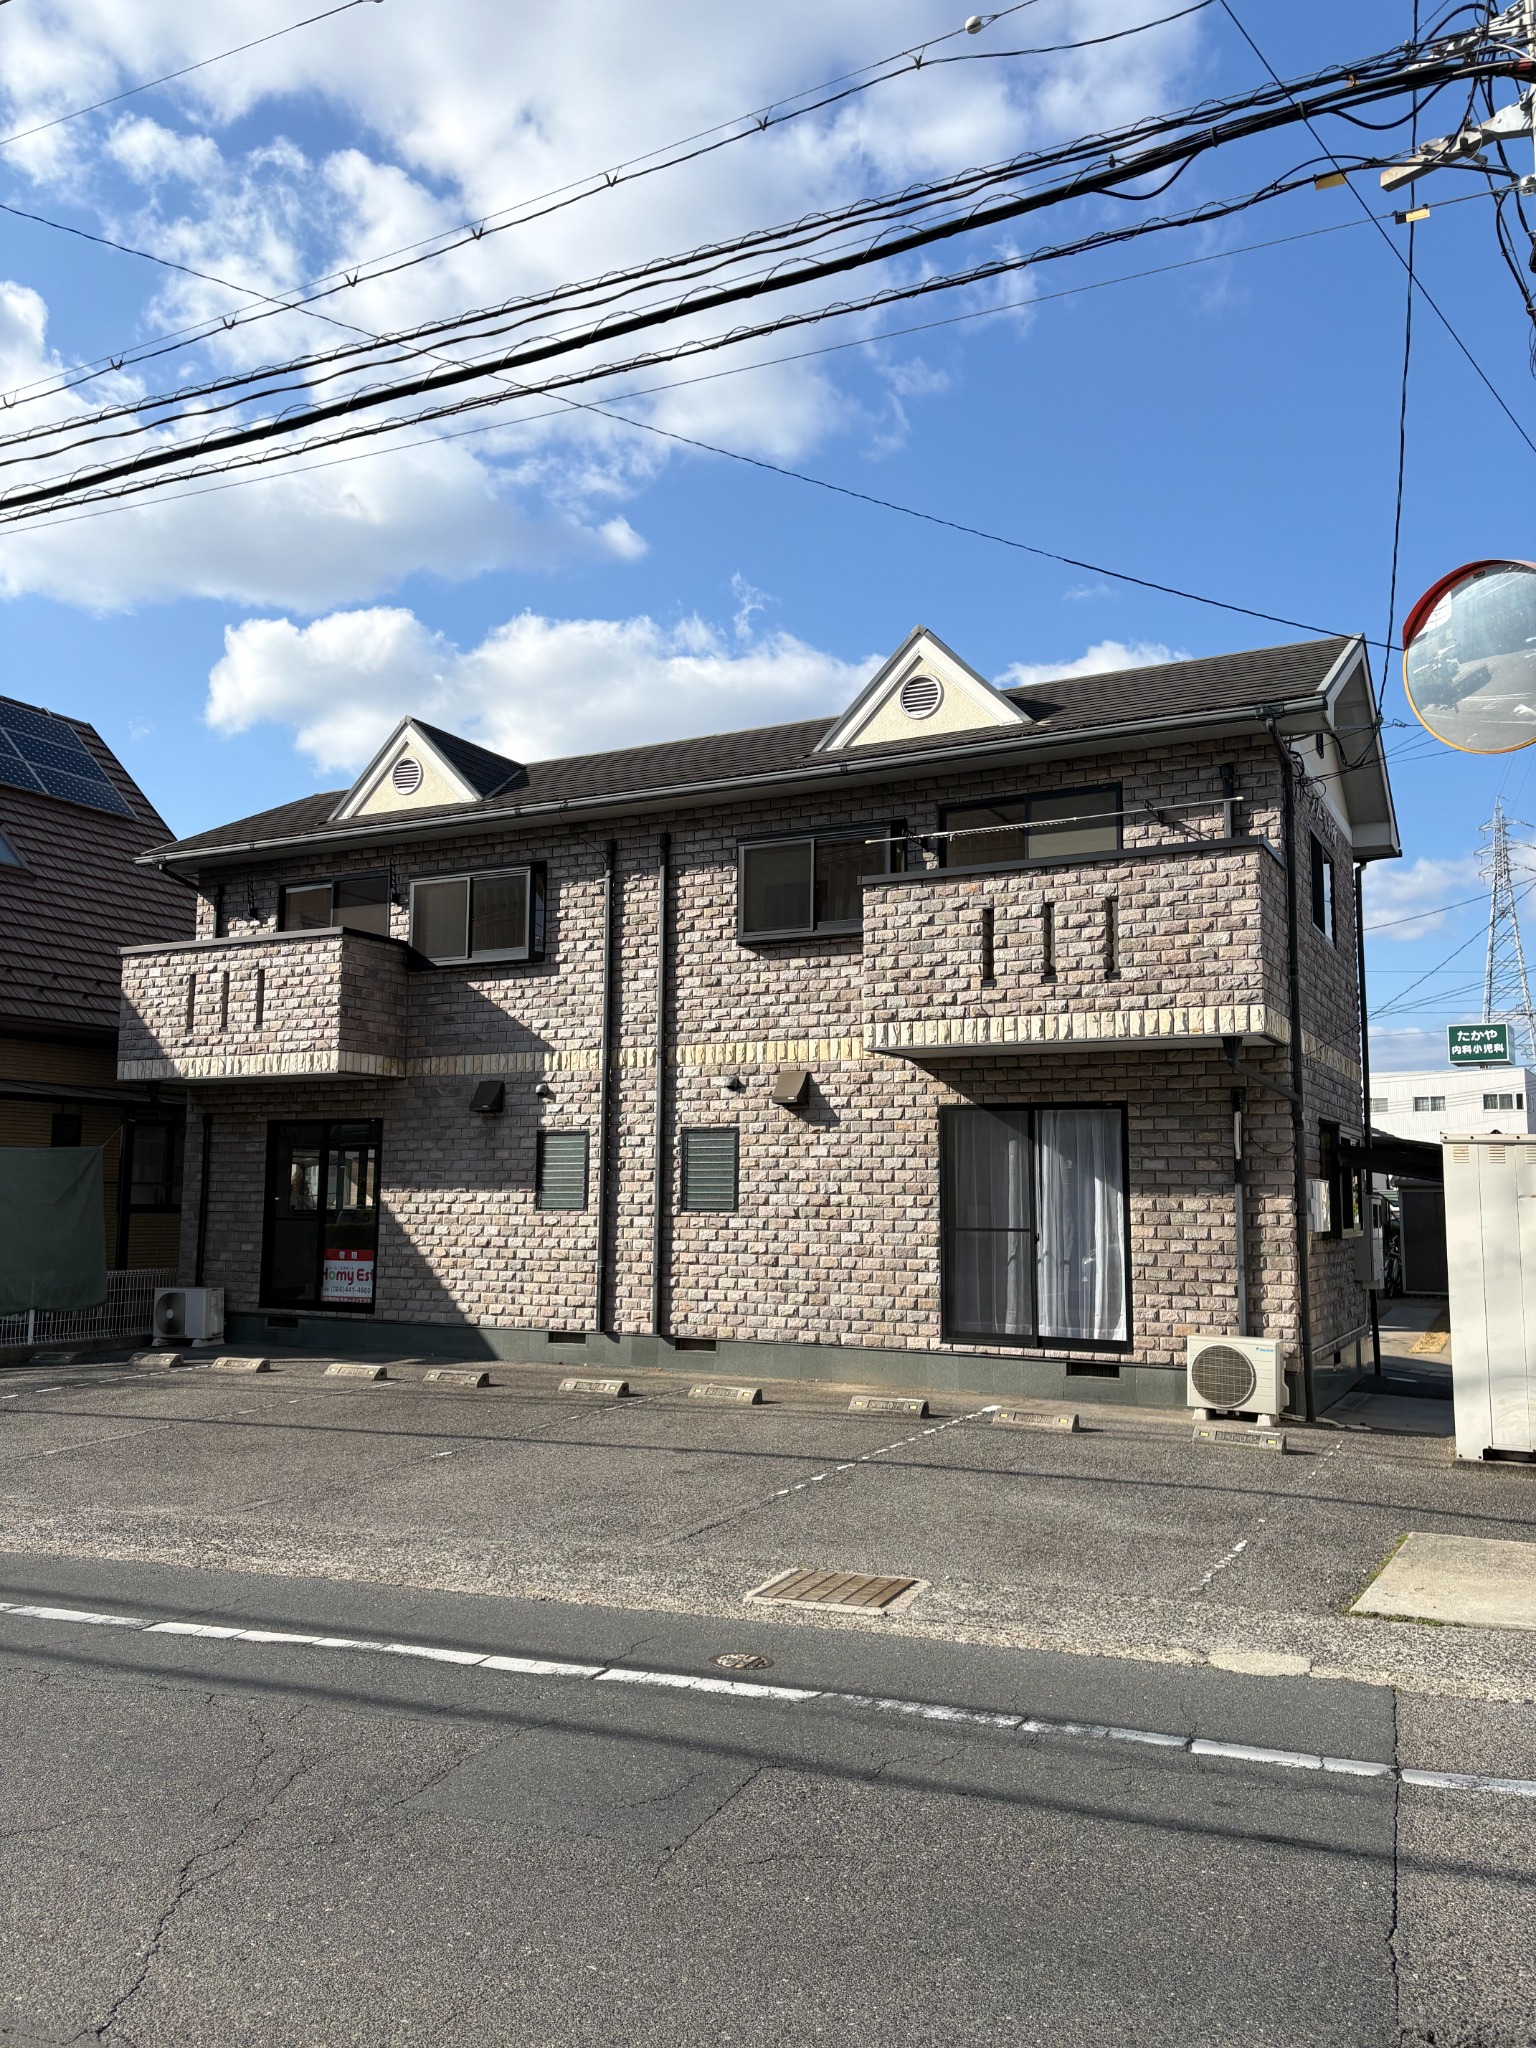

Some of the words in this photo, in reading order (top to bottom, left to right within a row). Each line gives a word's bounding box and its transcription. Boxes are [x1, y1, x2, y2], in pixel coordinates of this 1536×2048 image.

[1457, 1029, 1498, 1041] たかや
[1452, 1043, 1504, 1055] 内科小児科
